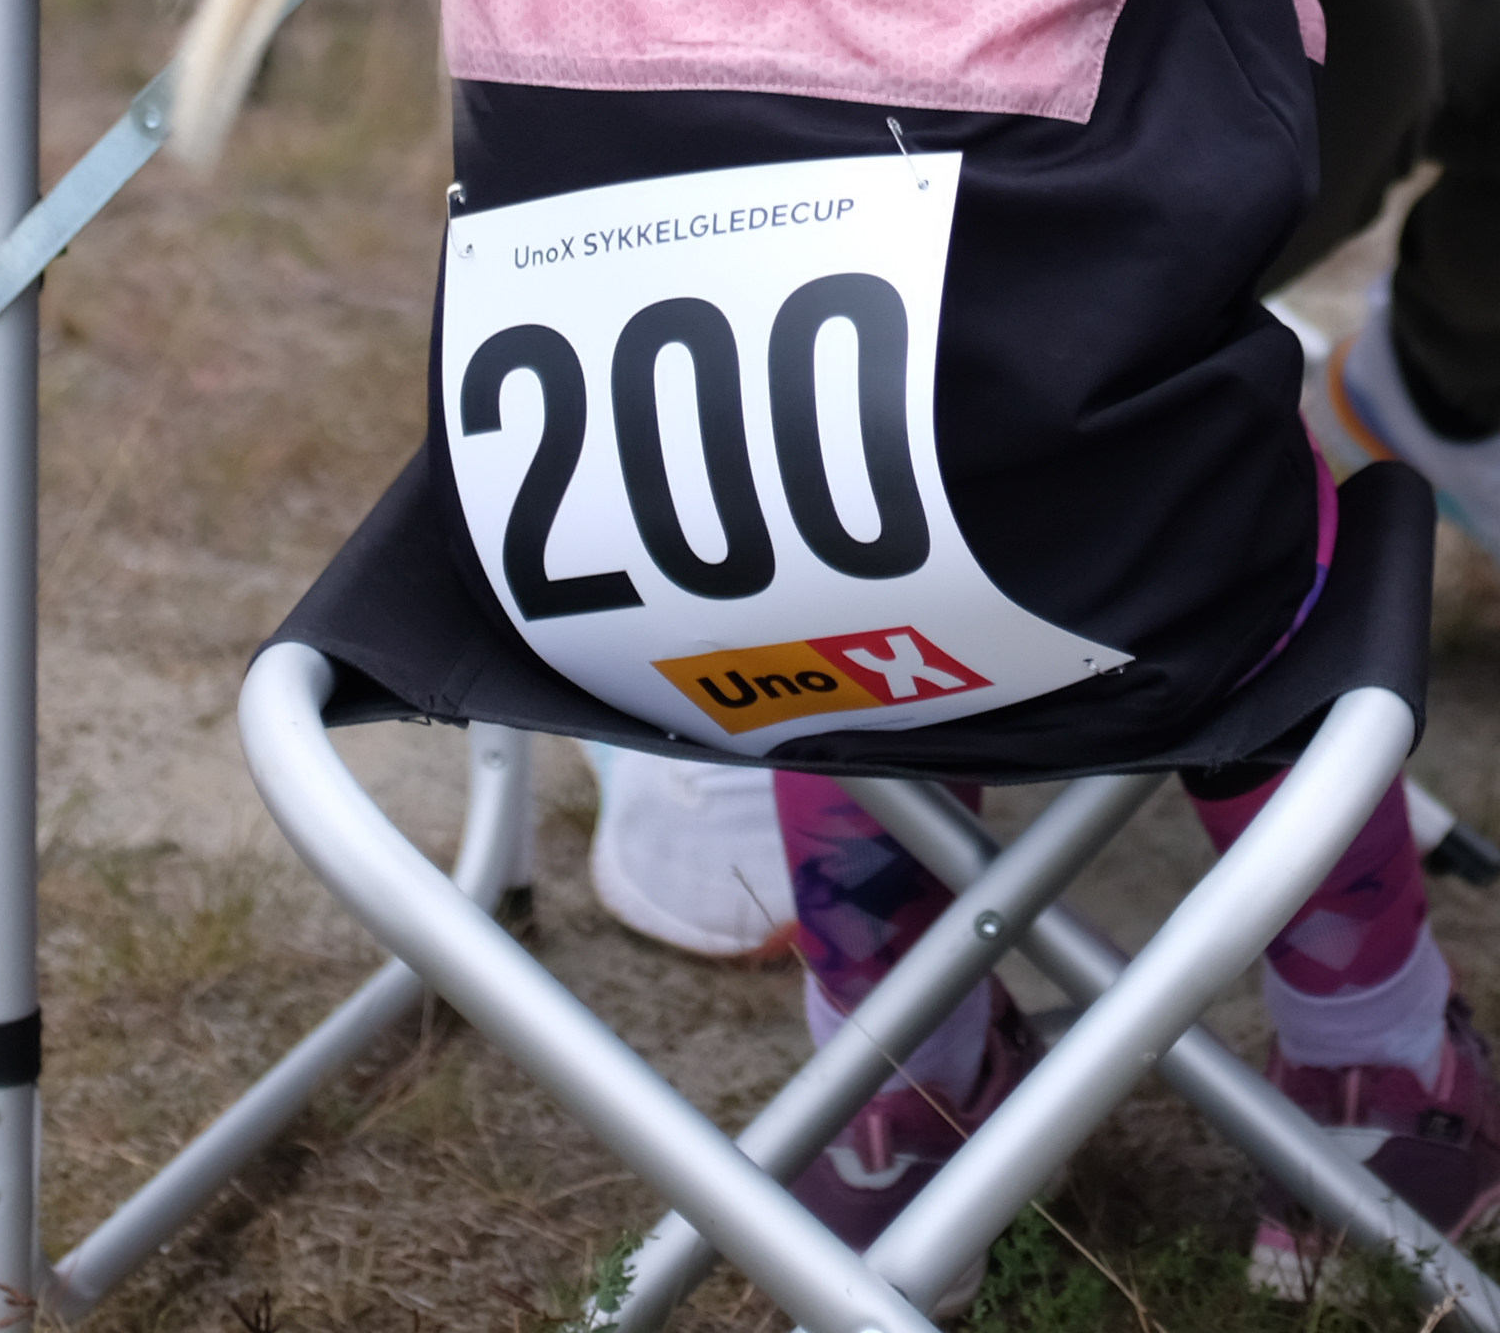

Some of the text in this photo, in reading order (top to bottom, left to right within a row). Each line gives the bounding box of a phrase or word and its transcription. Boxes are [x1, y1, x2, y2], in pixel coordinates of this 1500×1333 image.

[513, 198, 855, 270] UnoX SYKKELGLEDECUP
[460, 272, 931, 623] 200
